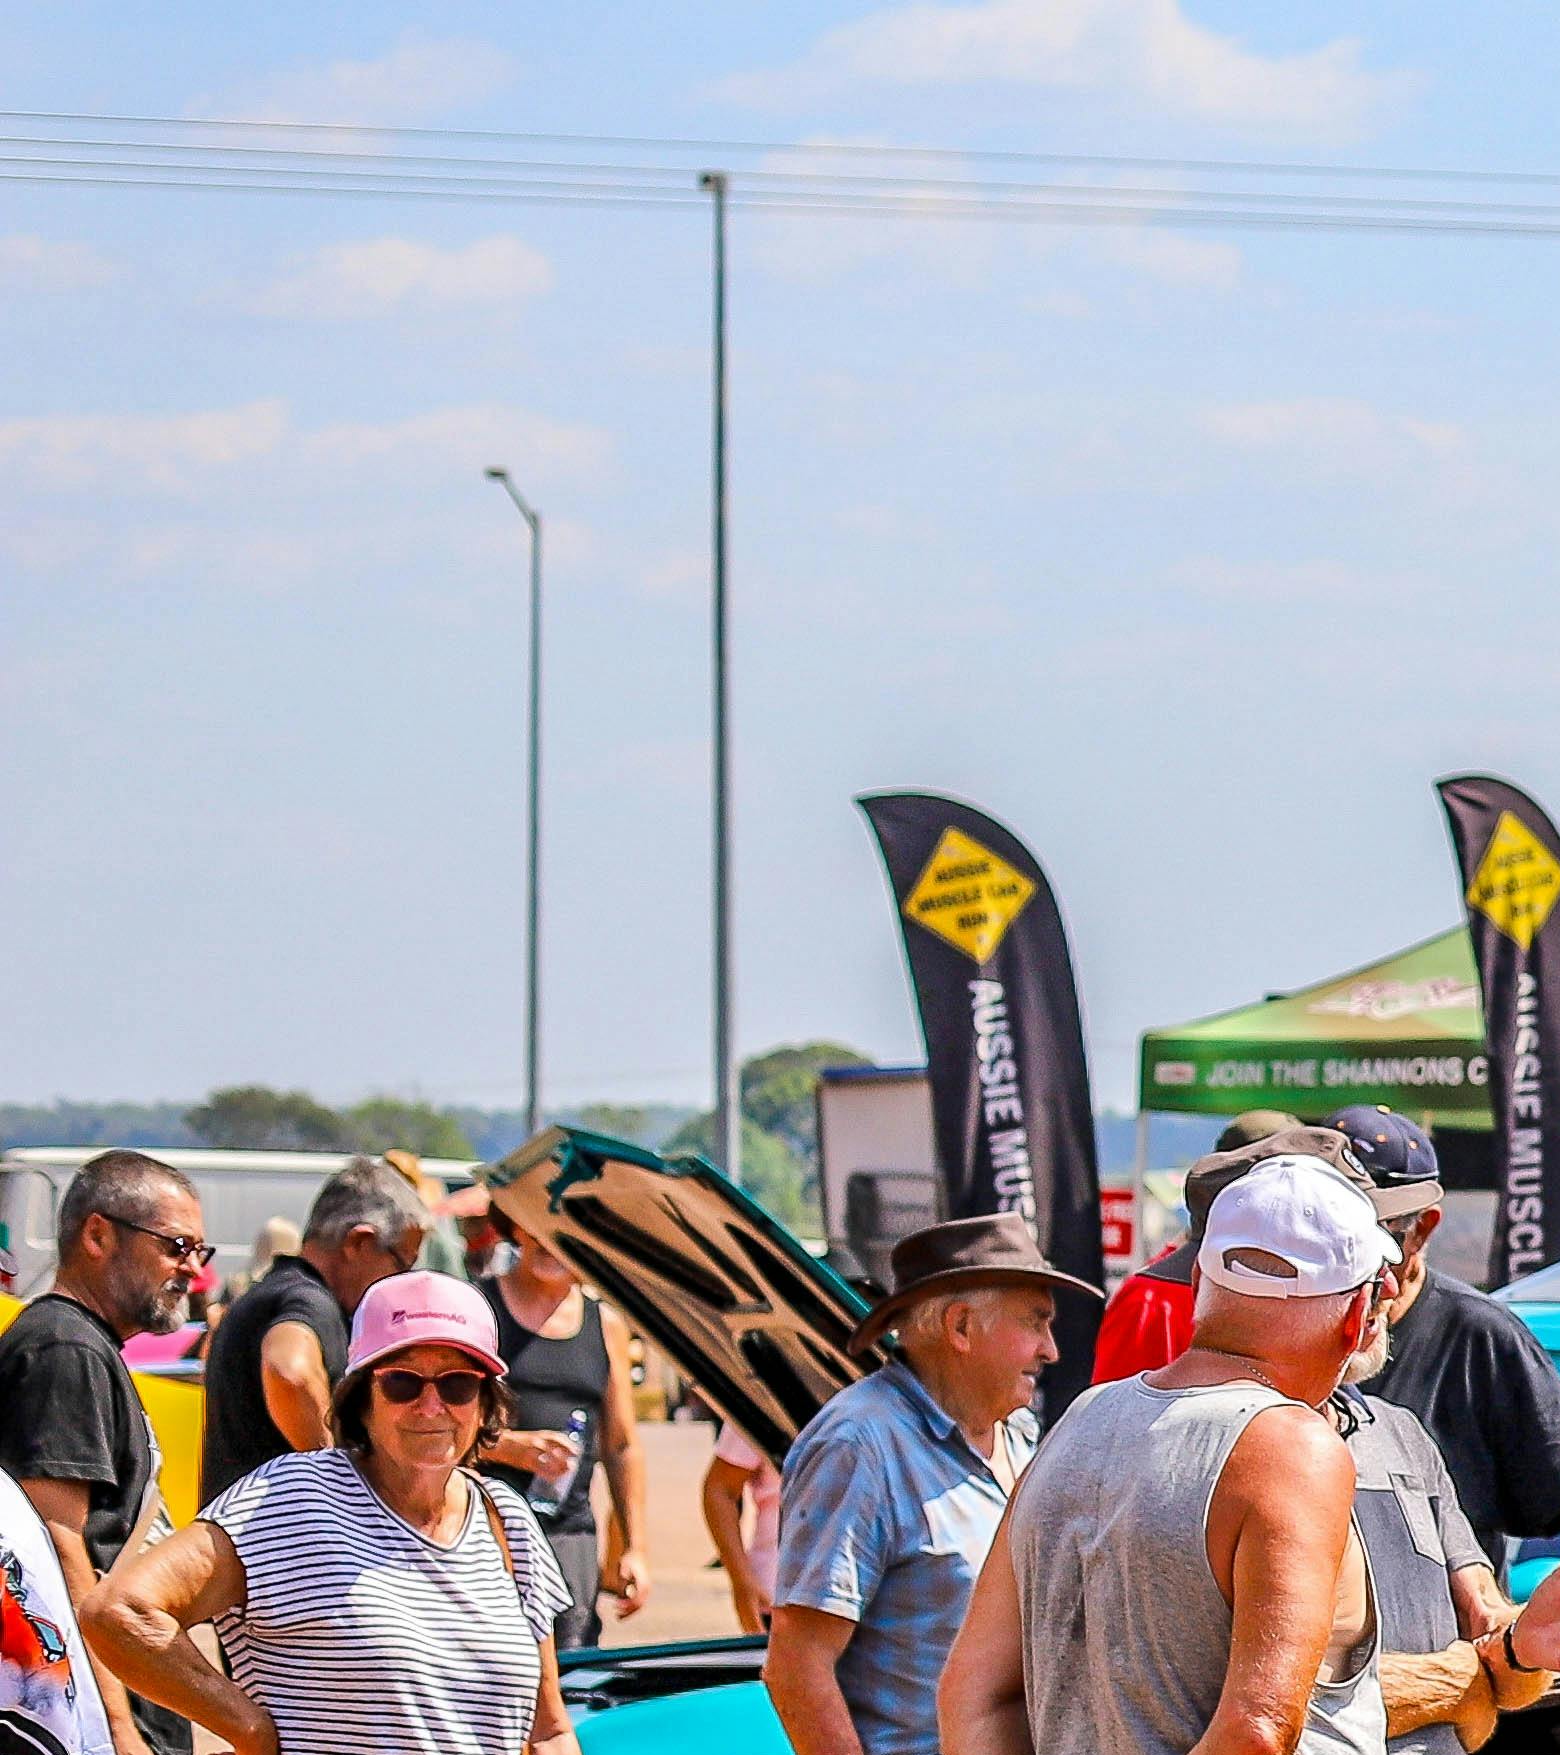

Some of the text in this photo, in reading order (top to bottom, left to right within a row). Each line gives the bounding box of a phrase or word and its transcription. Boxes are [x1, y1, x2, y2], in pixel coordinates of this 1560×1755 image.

[967, 978, 1024, 1127] AUSSIE
[1205, 1057, 1262, 1088] JOIN
[1272, 1057, 1319, 1087] THE
[1323, 1056, 1463, 1088] SHANNONS
